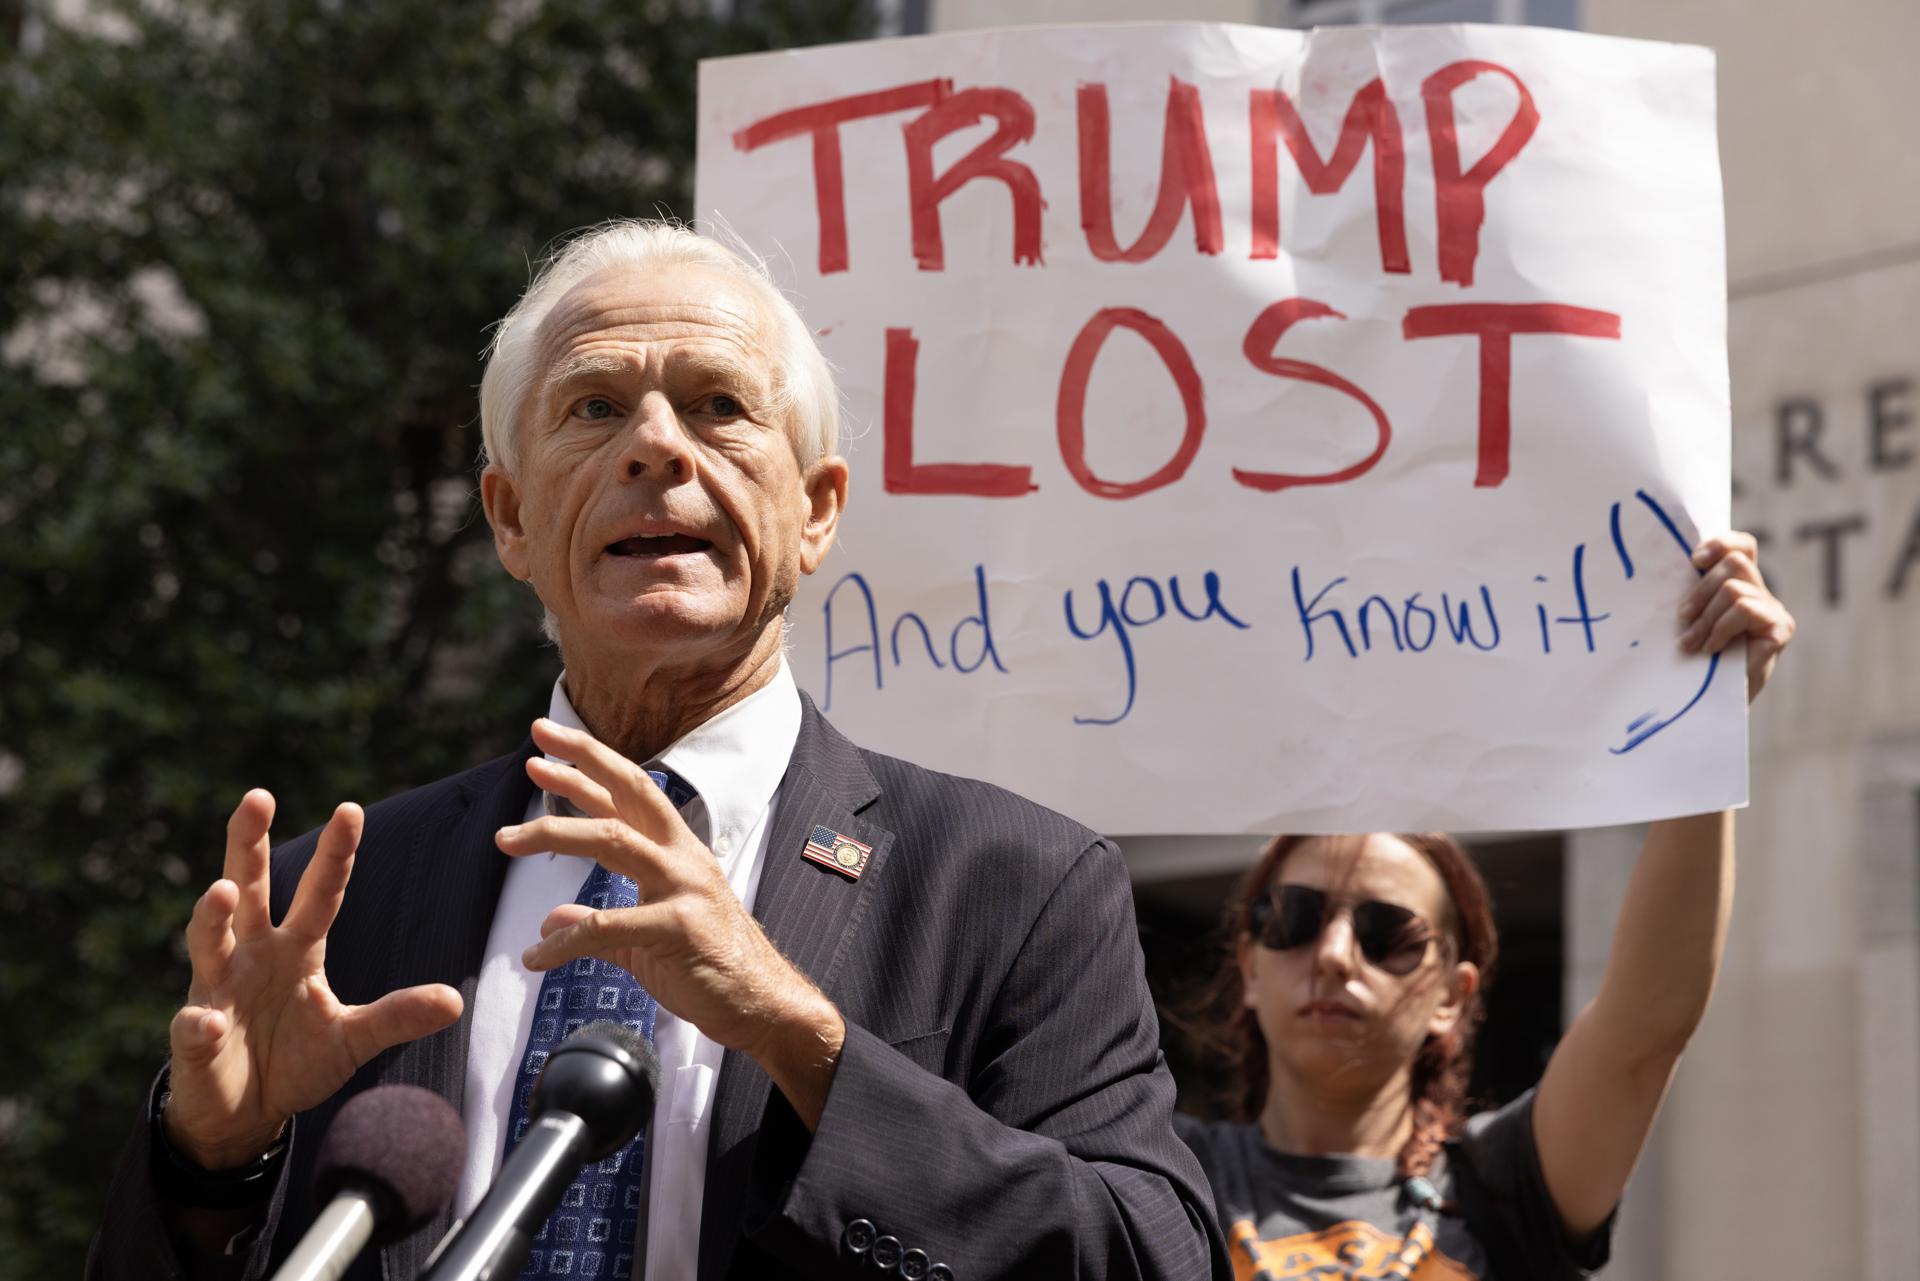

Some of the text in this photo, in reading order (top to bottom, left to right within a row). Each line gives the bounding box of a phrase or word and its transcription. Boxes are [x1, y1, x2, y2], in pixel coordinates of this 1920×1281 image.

[732, 60, 1542, 289] TRUMP
[883, 297, 1623, 500] LOST
[822, 564, 1010, 713] And
[1063, 571, 1252, 725] you
